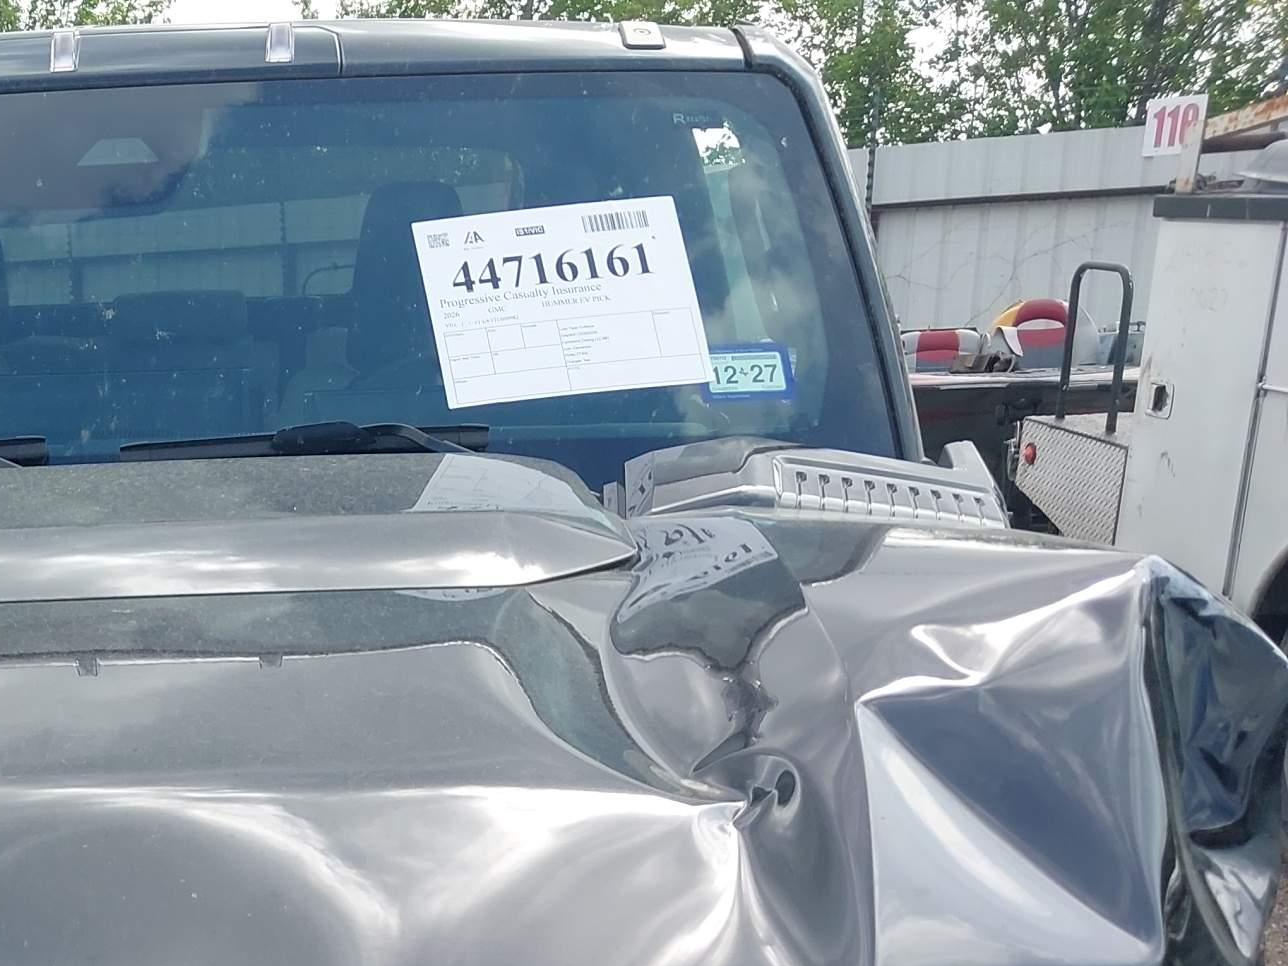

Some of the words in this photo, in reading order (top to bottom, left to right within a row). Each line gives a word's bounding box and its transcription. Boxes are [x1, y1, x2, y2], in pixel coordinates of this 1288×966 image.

[452, 242, 656, 293] 44716161
[439, 293, 501, 309] Progressive
[503, 288, 549, 301] Casualty
[551, 283, 602, 296] Insurance
[713, 365, 738, 384] 12
[750, 364, 777, 383] 27
